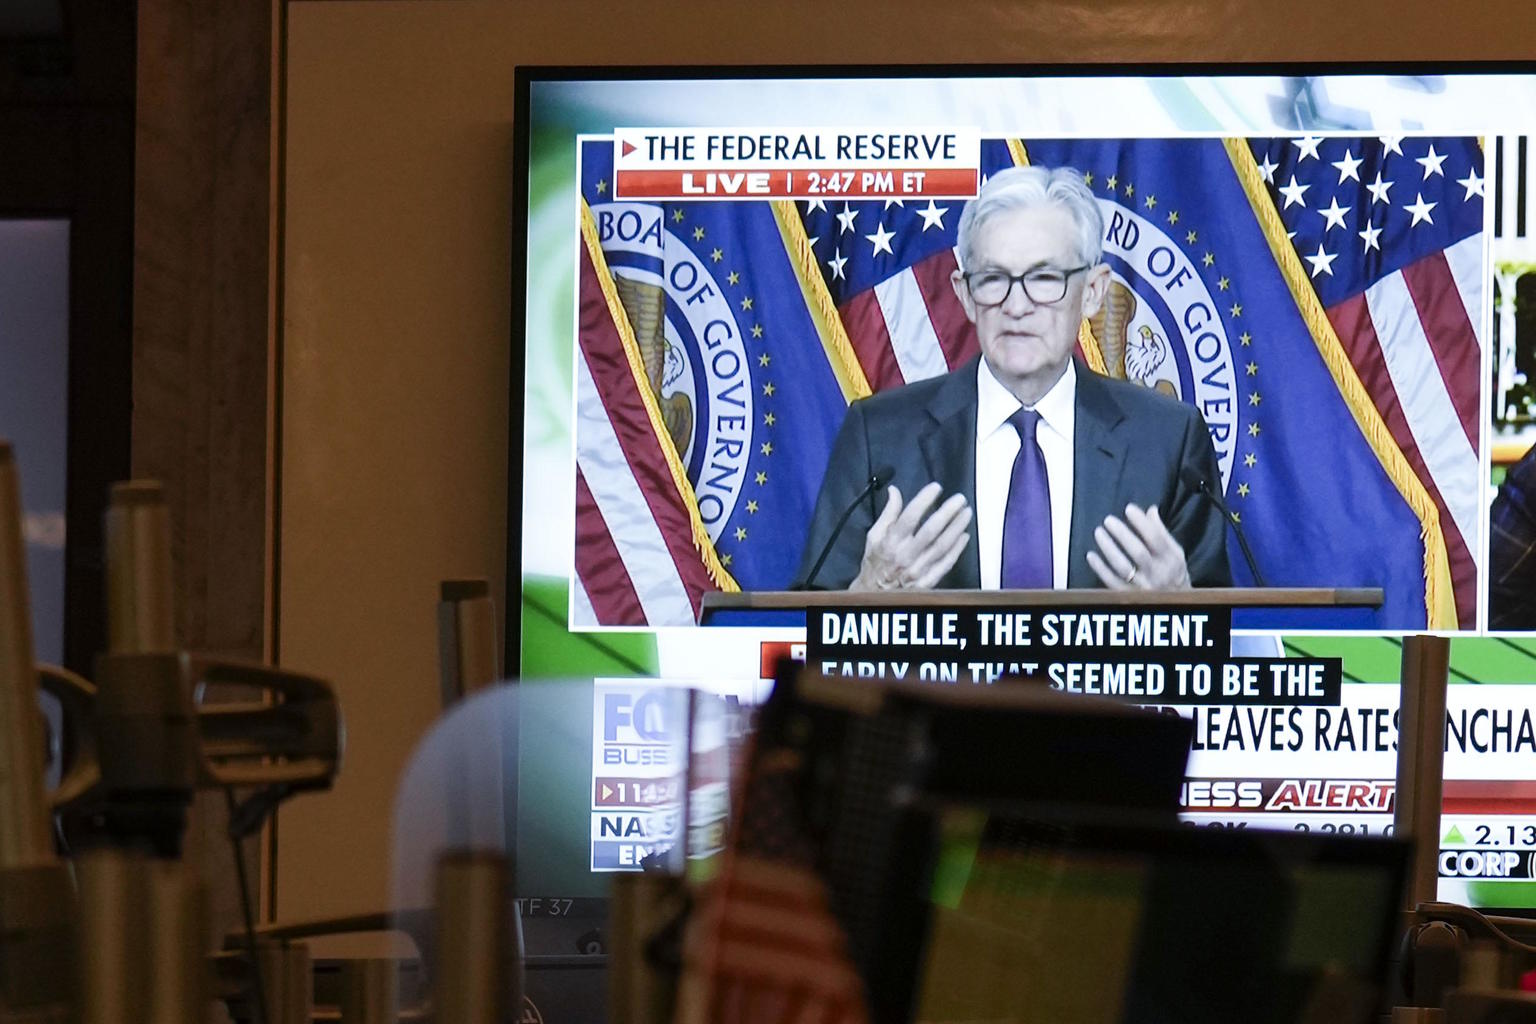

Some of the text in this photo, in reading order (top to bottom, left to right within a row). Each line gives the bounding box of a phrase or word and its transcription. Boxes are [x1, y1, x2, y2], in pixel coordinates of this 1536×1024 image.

[645, 134, 956, 161] THE FEDERAL RESERVE
[682, 172, 925, 194] LIVE 2:47 PM ET
[669, 260, 715, 305] OF
[1147, 246, 1193, 291] OF
[821, 612, 1214, 650] DANIELLE, THE STATEMENT.
[1047, 663, 1165, 695] SEEMED
[1175, 664, 1212, 696] TO
[1223, 664, 1260, 697] BE
[1270, 664, 1325, 697] THE
[1191, 706, 1304, 752] LEAVES
[1265, 779, 1396, 812] ALERT
[1439, 850, 1521, 877] CORP
[549, 898, 574, 916] 37
